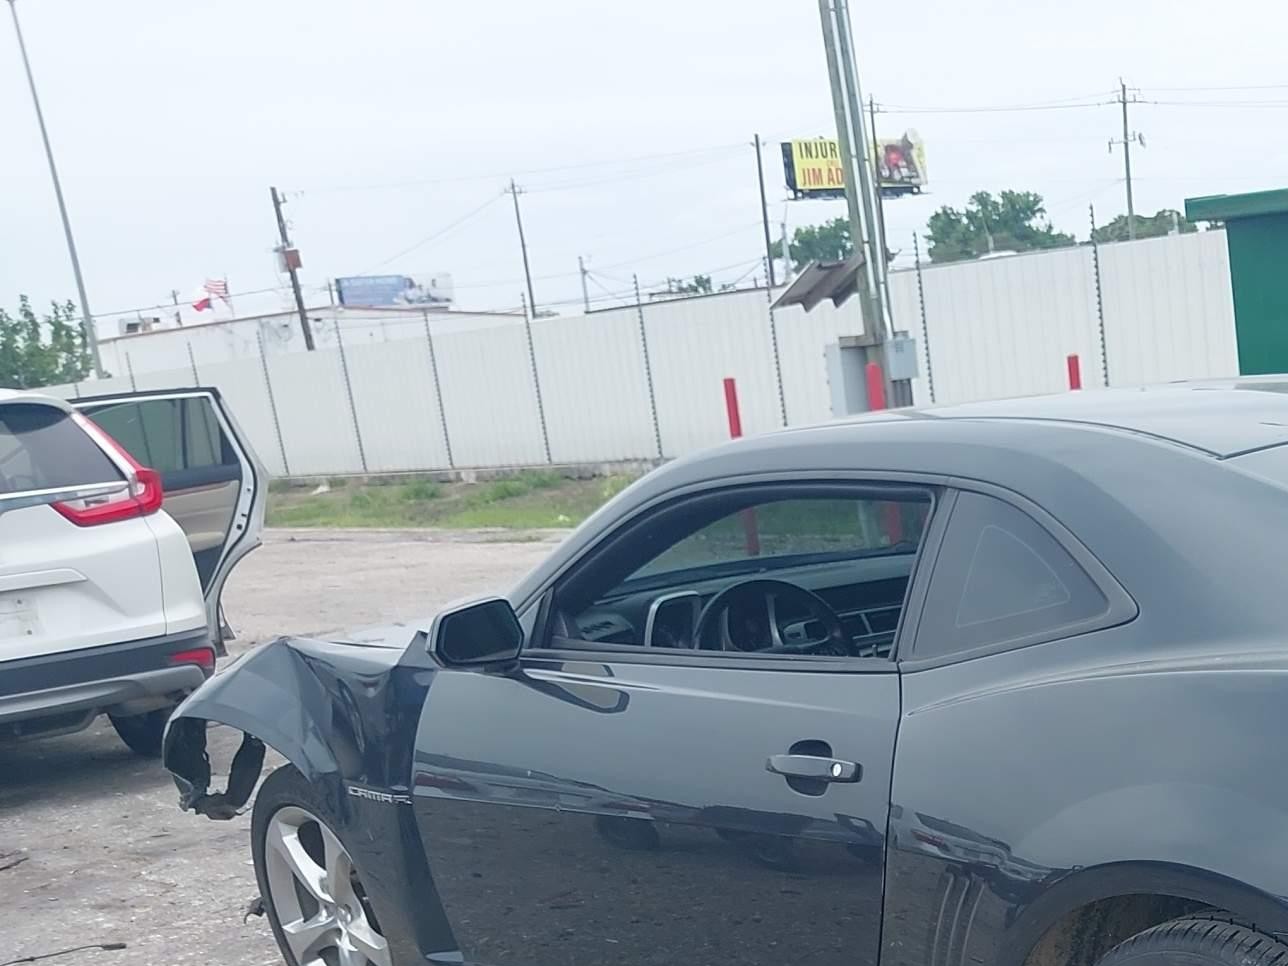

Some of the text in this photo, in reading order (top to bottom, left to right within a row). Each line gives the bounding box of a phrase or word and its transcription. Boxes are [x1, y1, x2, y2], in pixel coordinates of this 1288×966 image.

[798, 141, 838, 159] INJUR
[801, 167, 844, 187] JIM AD
